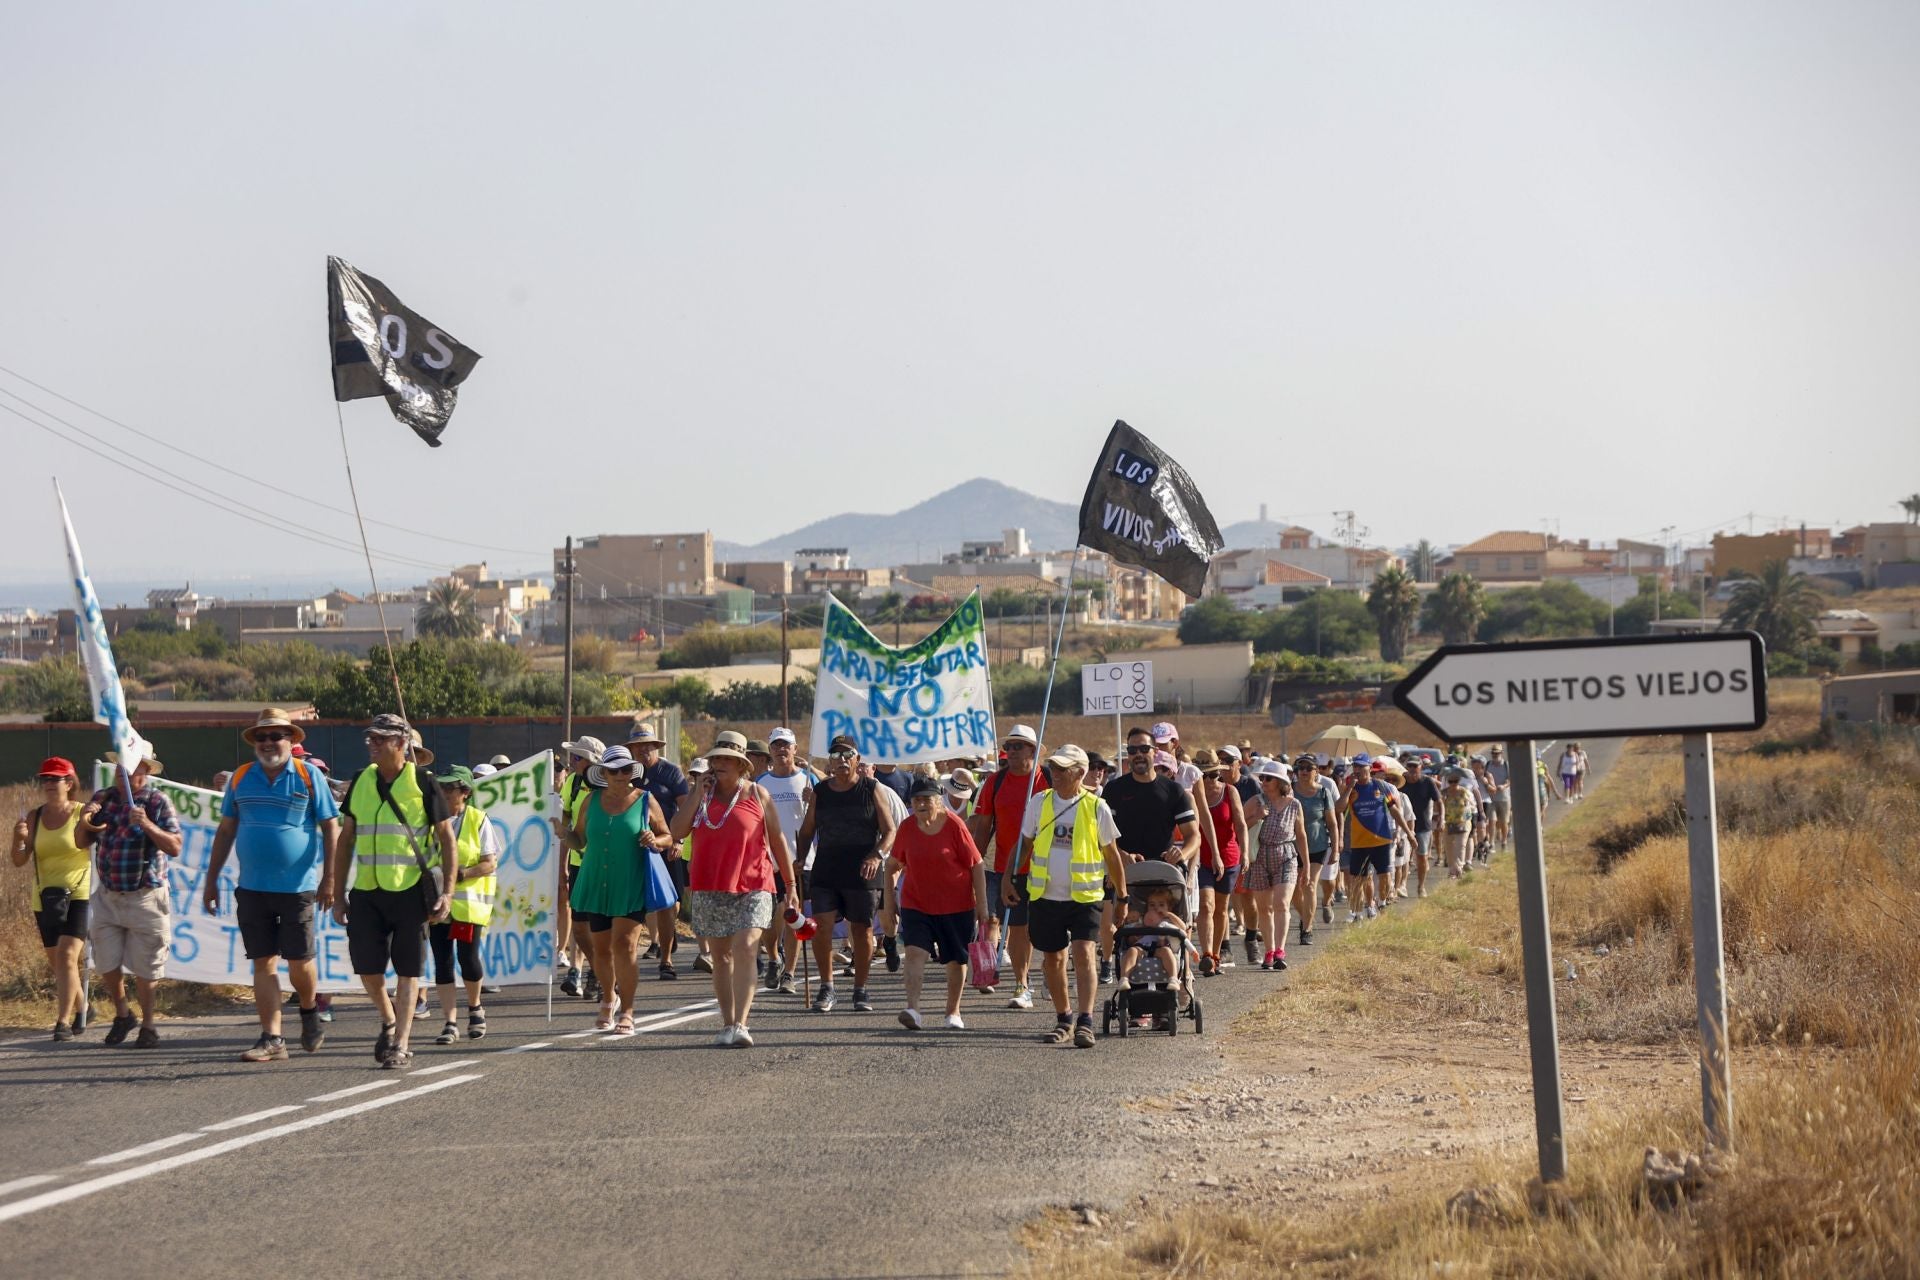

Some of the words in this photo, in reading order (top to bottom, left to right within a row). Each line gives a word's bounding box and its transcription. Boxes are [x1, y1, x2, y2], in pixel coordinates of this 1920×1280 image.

[379, 313, 459, 370] OS
[1115, 453, 1154, 484] LOS
[1102, 502, 1155, 547] VIVOS
[822, 637, 871, 682] PARA
[868, 679, 944, 718] NO
[1085, 693, 1148, 711] NIETOS
[1434, 682, 1495, 706] LOS
[1507, 675, 1625, 703] NIETOS
[1636, 669, 1749, 697] VIEJOS
[821, 709, 901, 759] PARA
